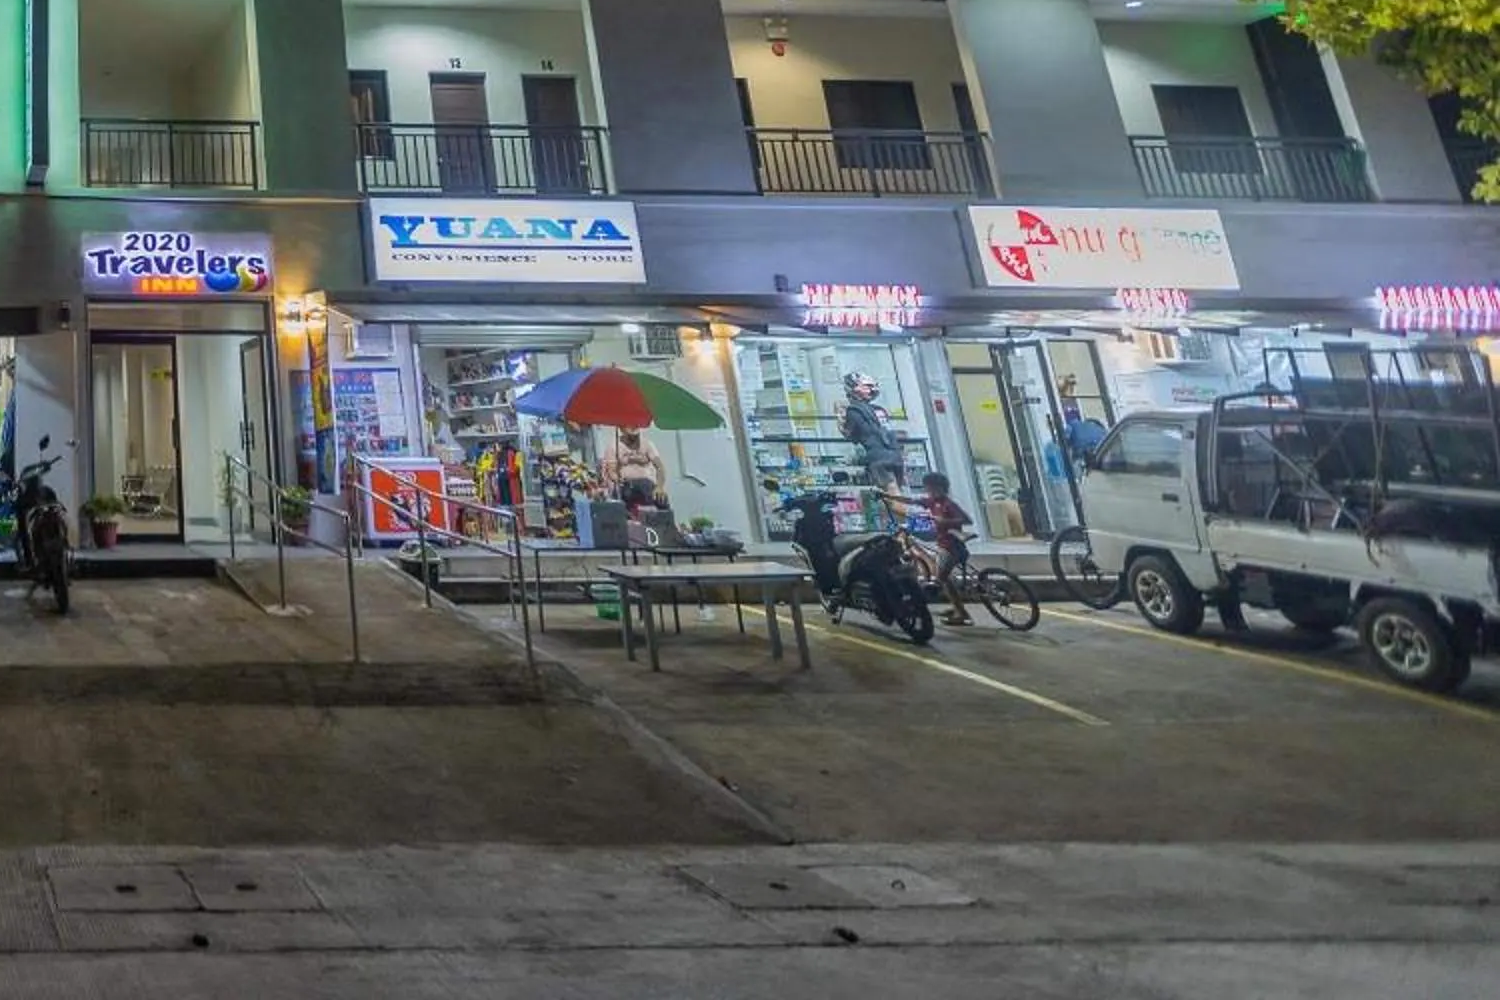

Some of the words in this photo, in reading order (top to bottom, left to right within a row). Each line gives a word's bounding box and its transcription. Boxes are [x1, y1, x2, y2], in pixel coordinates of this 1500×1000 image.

[379, 214, 630, 246] YUANA
[125, 233, 191, 252] 2020
[88, 249, 265, 275] Travelers
[140, 278, 198, 293] INN
